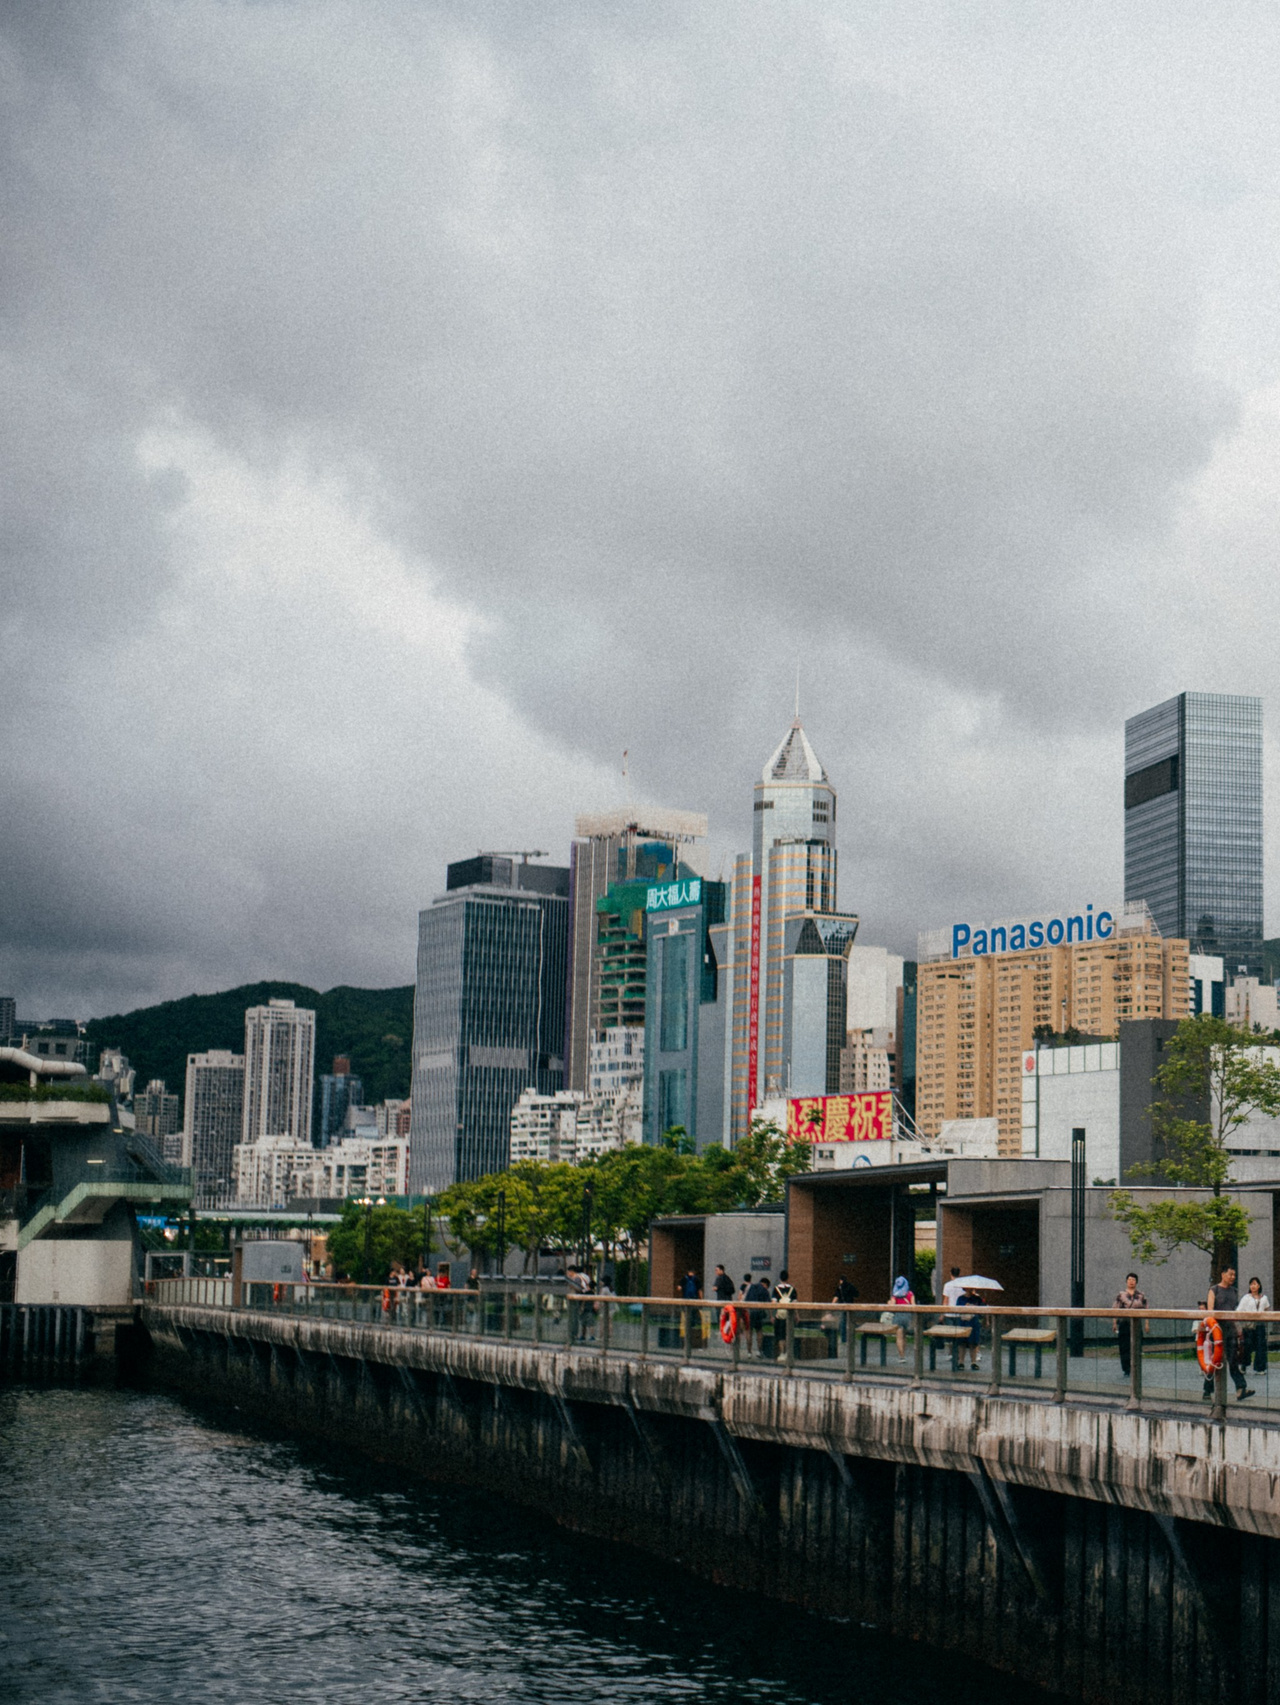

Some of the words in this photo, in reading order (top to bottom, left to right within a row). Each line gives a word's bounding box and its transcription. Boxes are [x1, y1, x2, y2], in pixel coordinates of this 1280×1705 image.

[646, 881, 700, 909] 周大福人壽
[952, 904, 1113, 958] Panasonic
